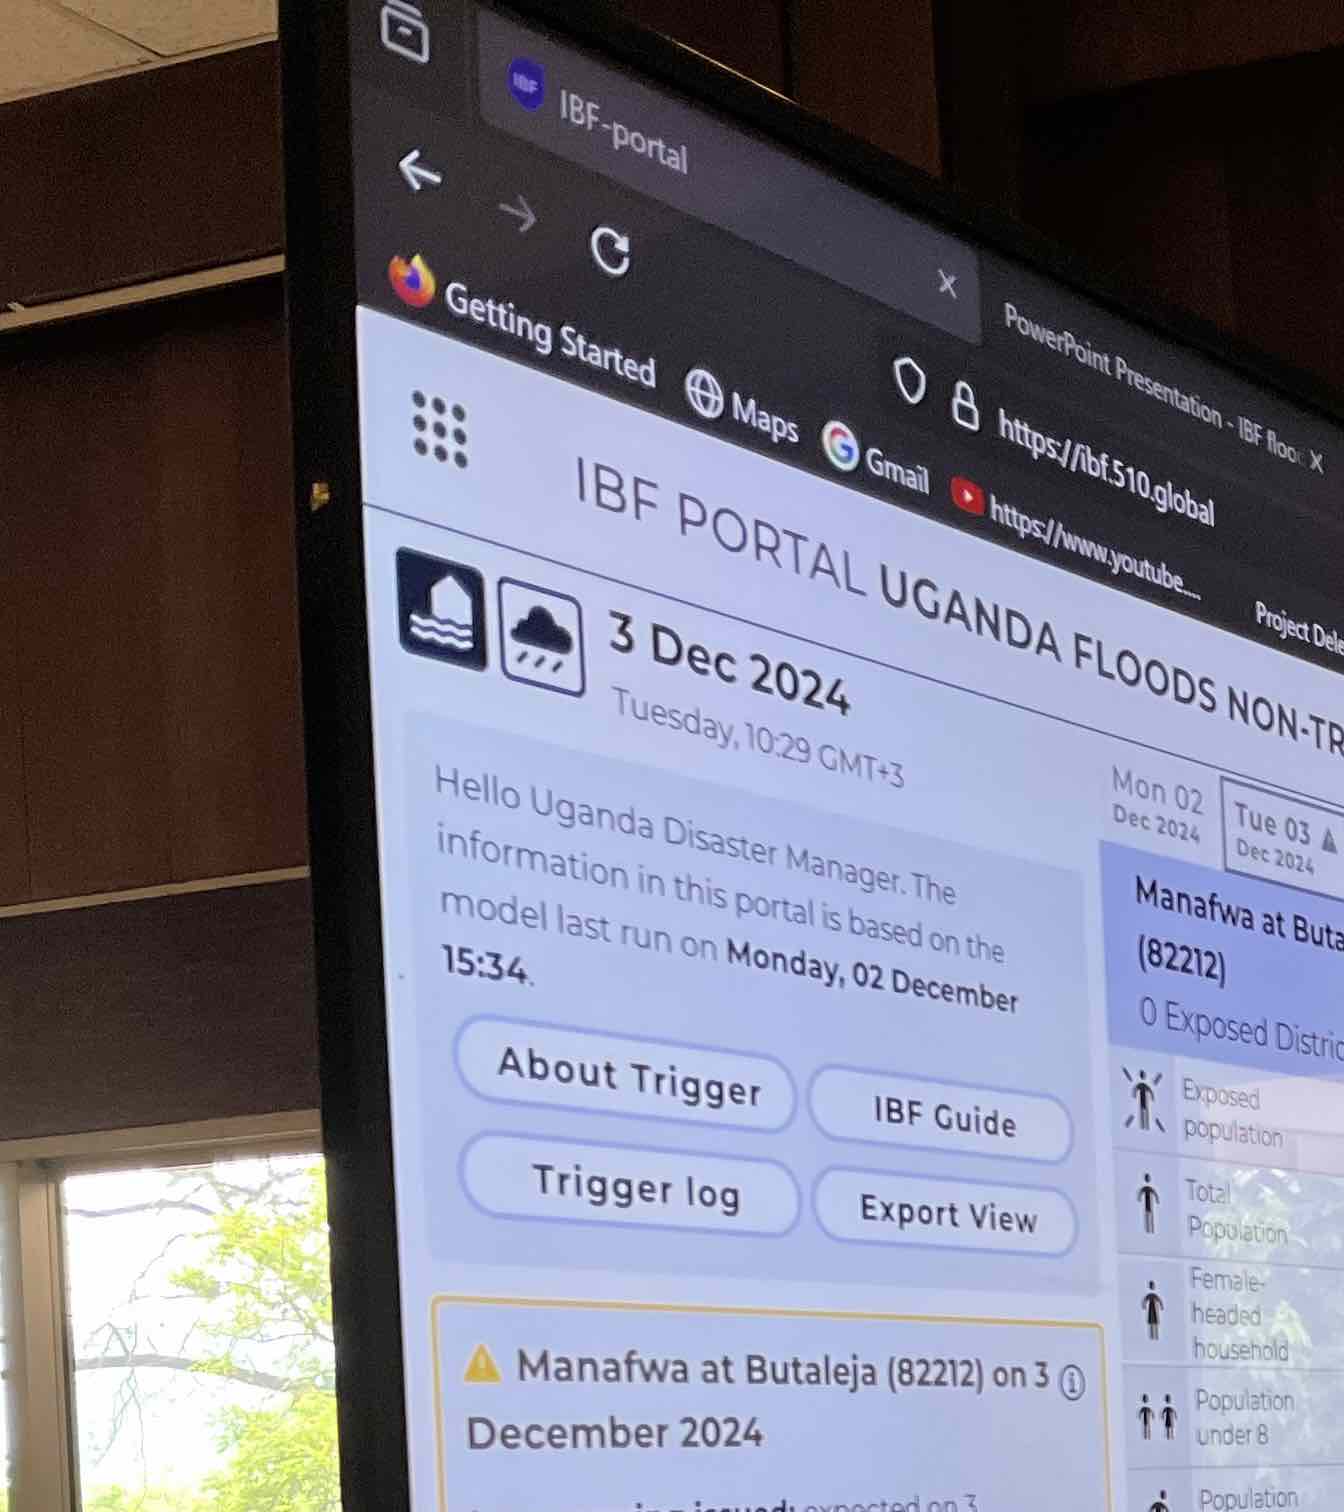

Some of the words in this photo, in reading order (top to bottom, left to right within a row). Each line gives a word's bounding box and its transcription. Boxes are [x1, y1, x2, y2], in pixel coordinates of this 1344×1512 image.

[560, 89, 689, 174] IBF-portal
[445, 283, 552, 355] Getting
[561, 326, 656, 389] Started
[1004, 303, 1112, 378] PowerPoint
[1116, 358, 1223, 430] Presentation
[1238, 417, 1263, 447] IBF
[732, 393, 799, 444] Maps
[866, 448, 929, 495] Gmail
[999, 408, 1215, 528] https://ibf.510.global
[578, 457, 659, 522] IBF
[679, 494, 866, 598] PORTAL
[880, 564, 1061, 665] UGANDA
[1074, 632, 1215, 712] FLOODS
[1256, 601, 1310, 642] Project
[609, 610, 635, 652] 3
[652, 623, 737, 684] Dec
[752, 654, 851, 716] 2024
[612, 686, 739, 750] Tuesday,
[745, 723, 811, 765] 10:29
[819, 744, 904, 790] GMT+3
[1112, 766, 1166, 801] Mon
[1174, 785, 1205, 815] 02
[435, 766, 520, 809] Hello
[530, 788, 654, 839] Uganda
[664, 817, 777, 865] Disaster
[786, 845, 904, 894] Manager.
[911, 873, 957, 906] The
[1113, 803, 1150, 831] Dec
[1156, 817, 1200, 844] 2024
[1234, 802, 1277, 836] Tue
[1285, 817, 1311, 844] 03
[1236, 839, 1270, 863] Dec
[1275, 850, 1315, 876] 2024
[436, 823, 630, 889] information
[637, 859, 666, 894] in
[673, 868, 728, 909] this
[735, 885, 816, 927] portal
[822, 903, 842, 932] is
[848, 908, 923, 947] based
[930, 931, 960, 957] on
[965, 933, 1005, 964] the
[1135, 875, 1253, 931] Manafwa
[1263, 911, 1285, 938] at
[442, 891, 548, 932] model
[557, 905, 610, 942] last
[620, 928, 672, 957] run
[680, 937, 718, 961] on
[726, 940, 846, 989] Monday,
[853, 963, 884, 990] 02
[892, 969, 1018, 1014] December
[443, 943, 534, 987] 15:34.
[1138, 934, 1225, 988] (82212)
[1166, 1000, 1268, 1046] Exposed
[497, 1047, 617, 1090] About
[631, 1063, 761, 1109] Trigger
[1184, 1078, 1261, 1110] Exposed
[874, 1096, 923, 1126] IBF
[935, 1105, 1017, 1138] Guide
[1184, 1118, 1284, 1149] population
[533, 1165, 671, 1207] Trigger
[688, 1176, 740, 1216] log
[861, 1195, 959, 1227] Export
[970, 1203, 1038, 1233] View
[517, 1349, 689, 1384] Manafwa
[701, 1357, 735, 1384] at
[745, 1355, 877, 1389] Butaleja
[887, 1357, 985, 1393] (82212)
[993, 1362, 1027, 1388] on
[1034, 1361, 1049, 1388] 3
[1197, 1390, 1295, 1412] Population
[468, 1416, 668, 1451] December
[680, 1417, 763, 1448] 2024
[1197, 1427, 1252, 1446] under
